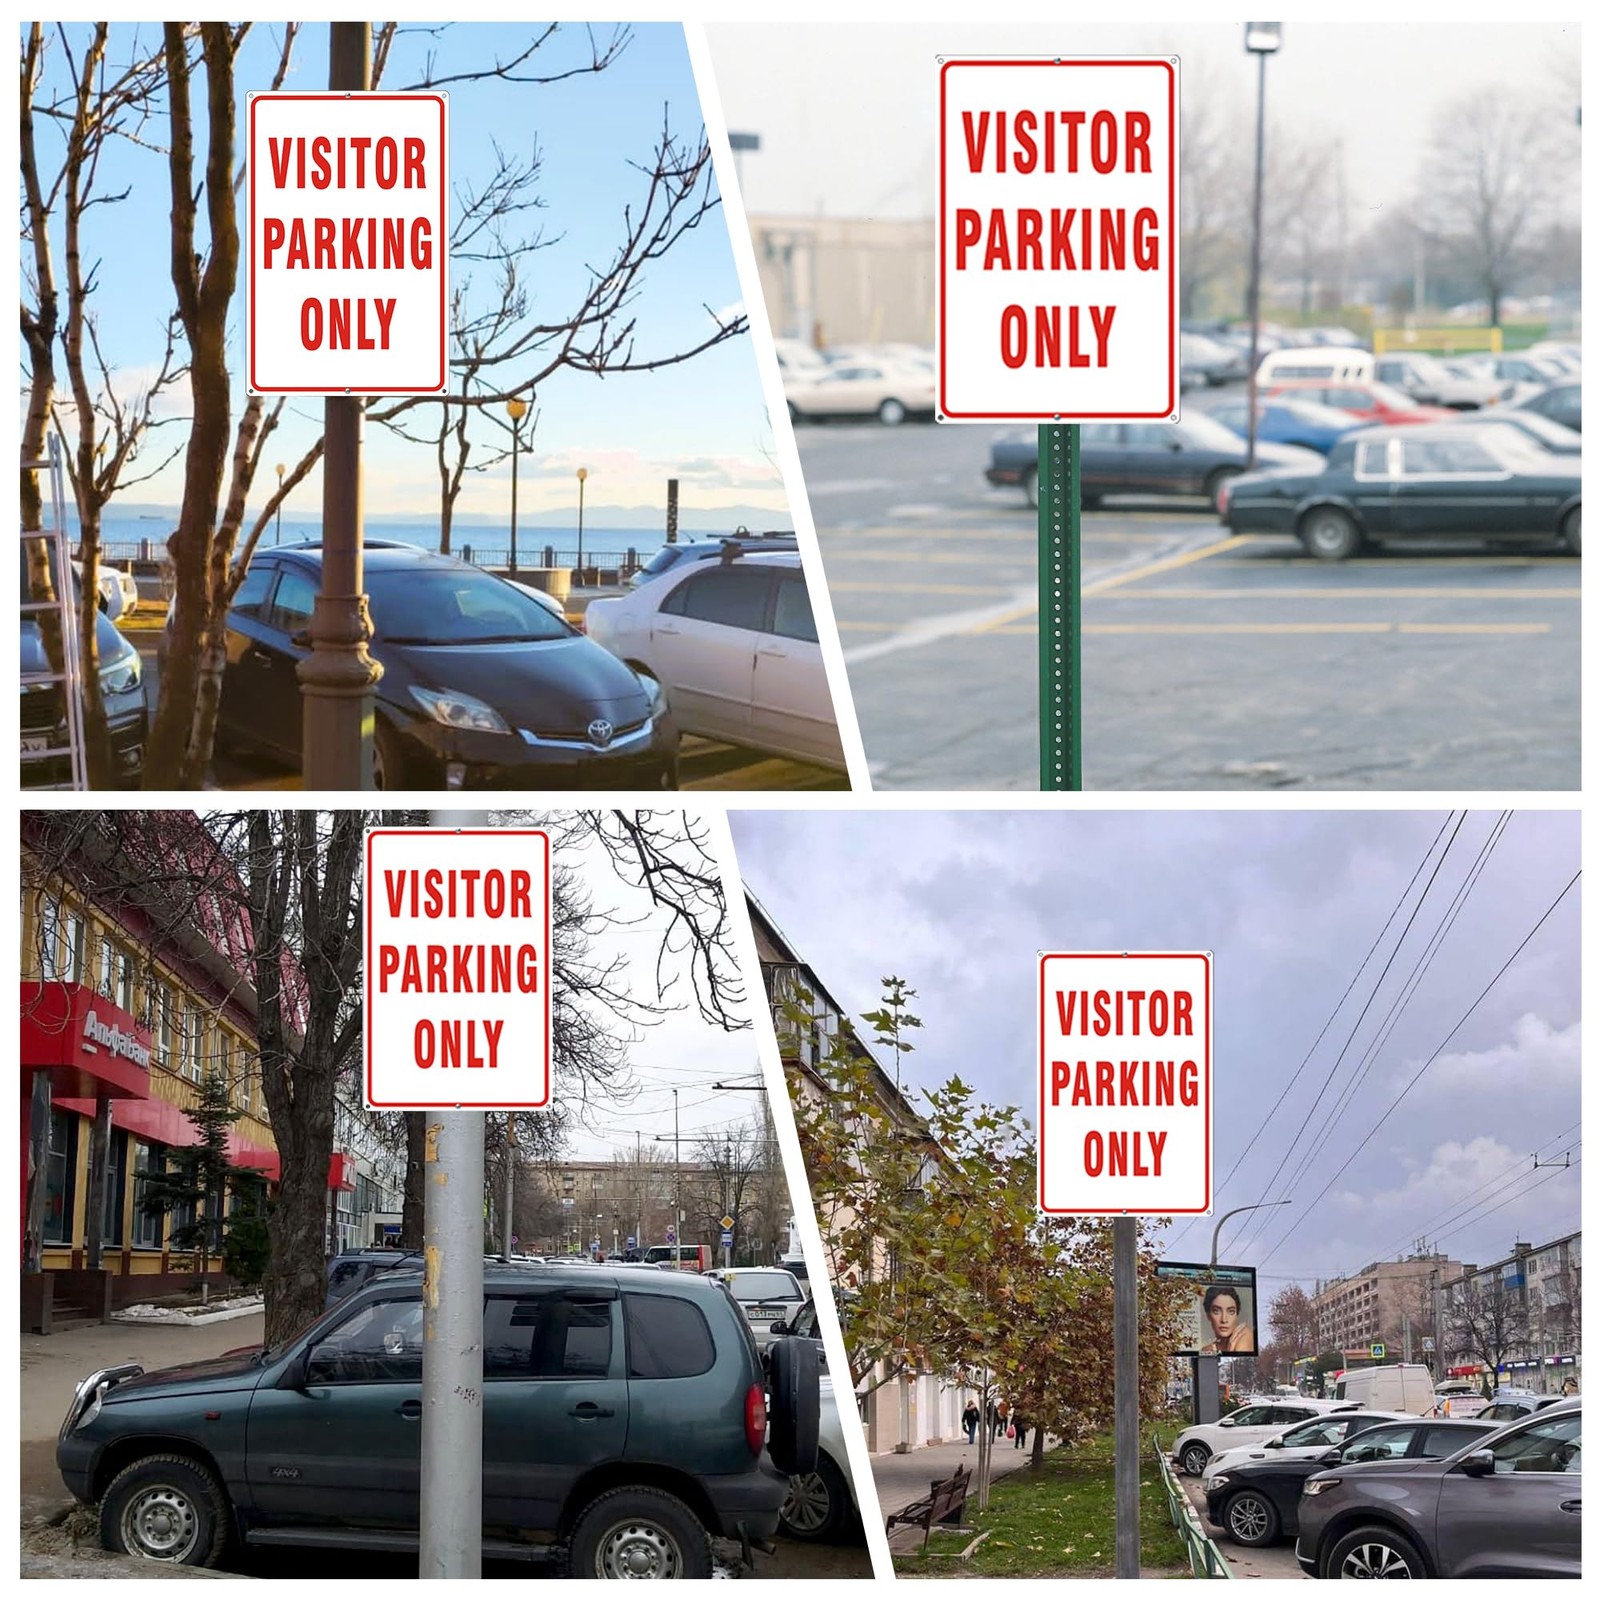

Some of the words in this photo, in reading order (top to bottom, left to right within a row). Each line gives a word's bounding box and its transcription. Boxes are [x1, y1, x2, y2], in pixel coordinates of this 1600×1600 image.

[269, 136, 426, 190] VISITOR
[962, 110, 1152, 175] VISITOR
[264, 217, 432, 270] PARKING
[956, 207, 1159, 271] PARKING
[301, 298, 396, 351] ONLY
[1001, 304, 1116, 369] ONLY
[384, 869, 531, 919] VISITOR
[380, 944, 537, 994] PARKING
[1056, 990, 1193, 1037] VISITOR
[414, 1019, 504, 1069] ONLY
[1052, 1060, 1198, 1106] PARKING
[1084, 1130, 1167, 1177] ONLY
